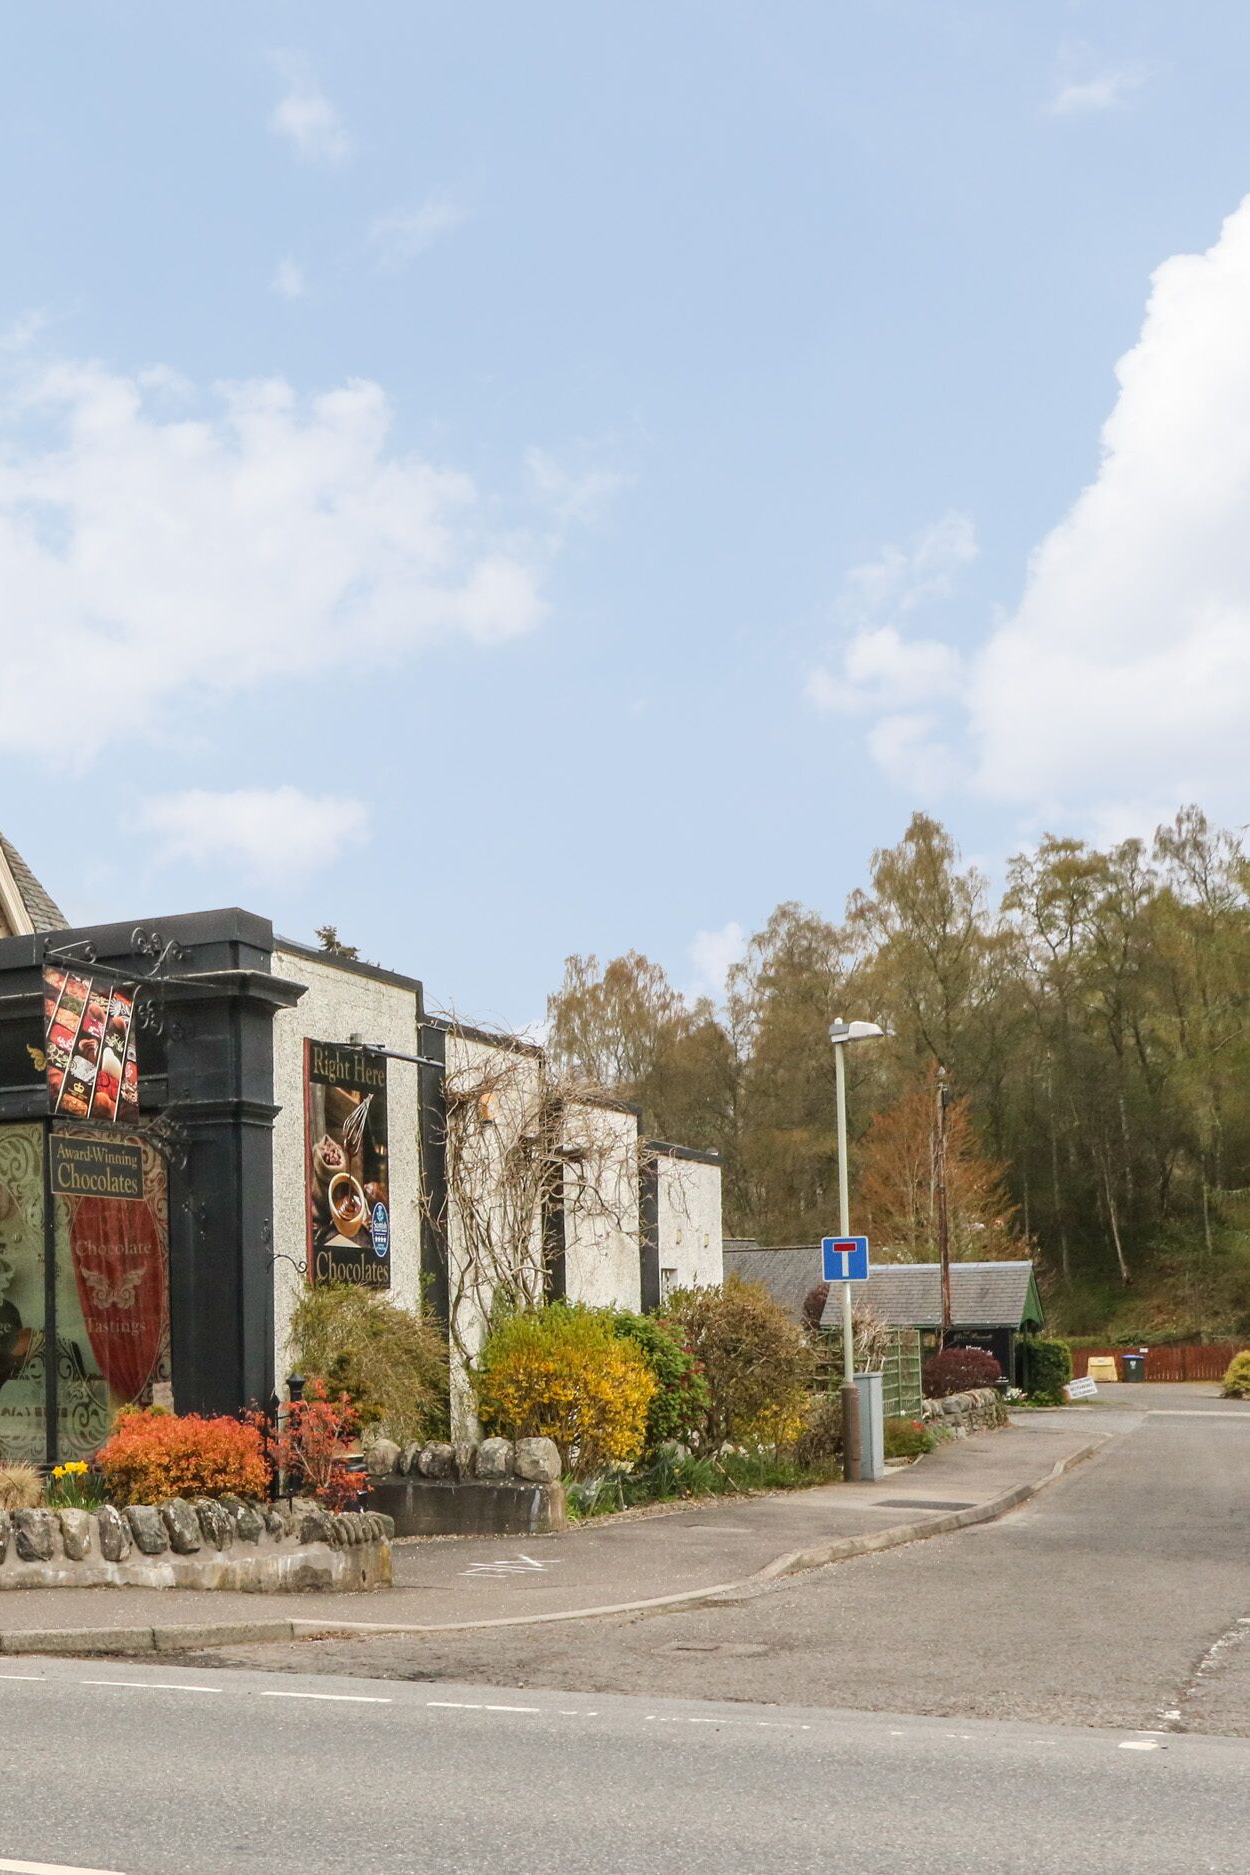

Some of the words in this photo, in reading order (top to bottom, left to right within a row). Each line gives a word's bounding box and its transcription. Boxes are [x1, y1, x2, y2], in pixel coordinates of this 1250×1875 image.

[313, 1046, 349, 1084] Right
[354, 1055, 385, 1088] Here
[56, 1143, 137, 1169] Award-Winning
[57, 1162, 138, 1194] Chocolates
[75, 1239, 152, 1257] Chocolate
[316, 1250, 389, 1284] Chocolates
